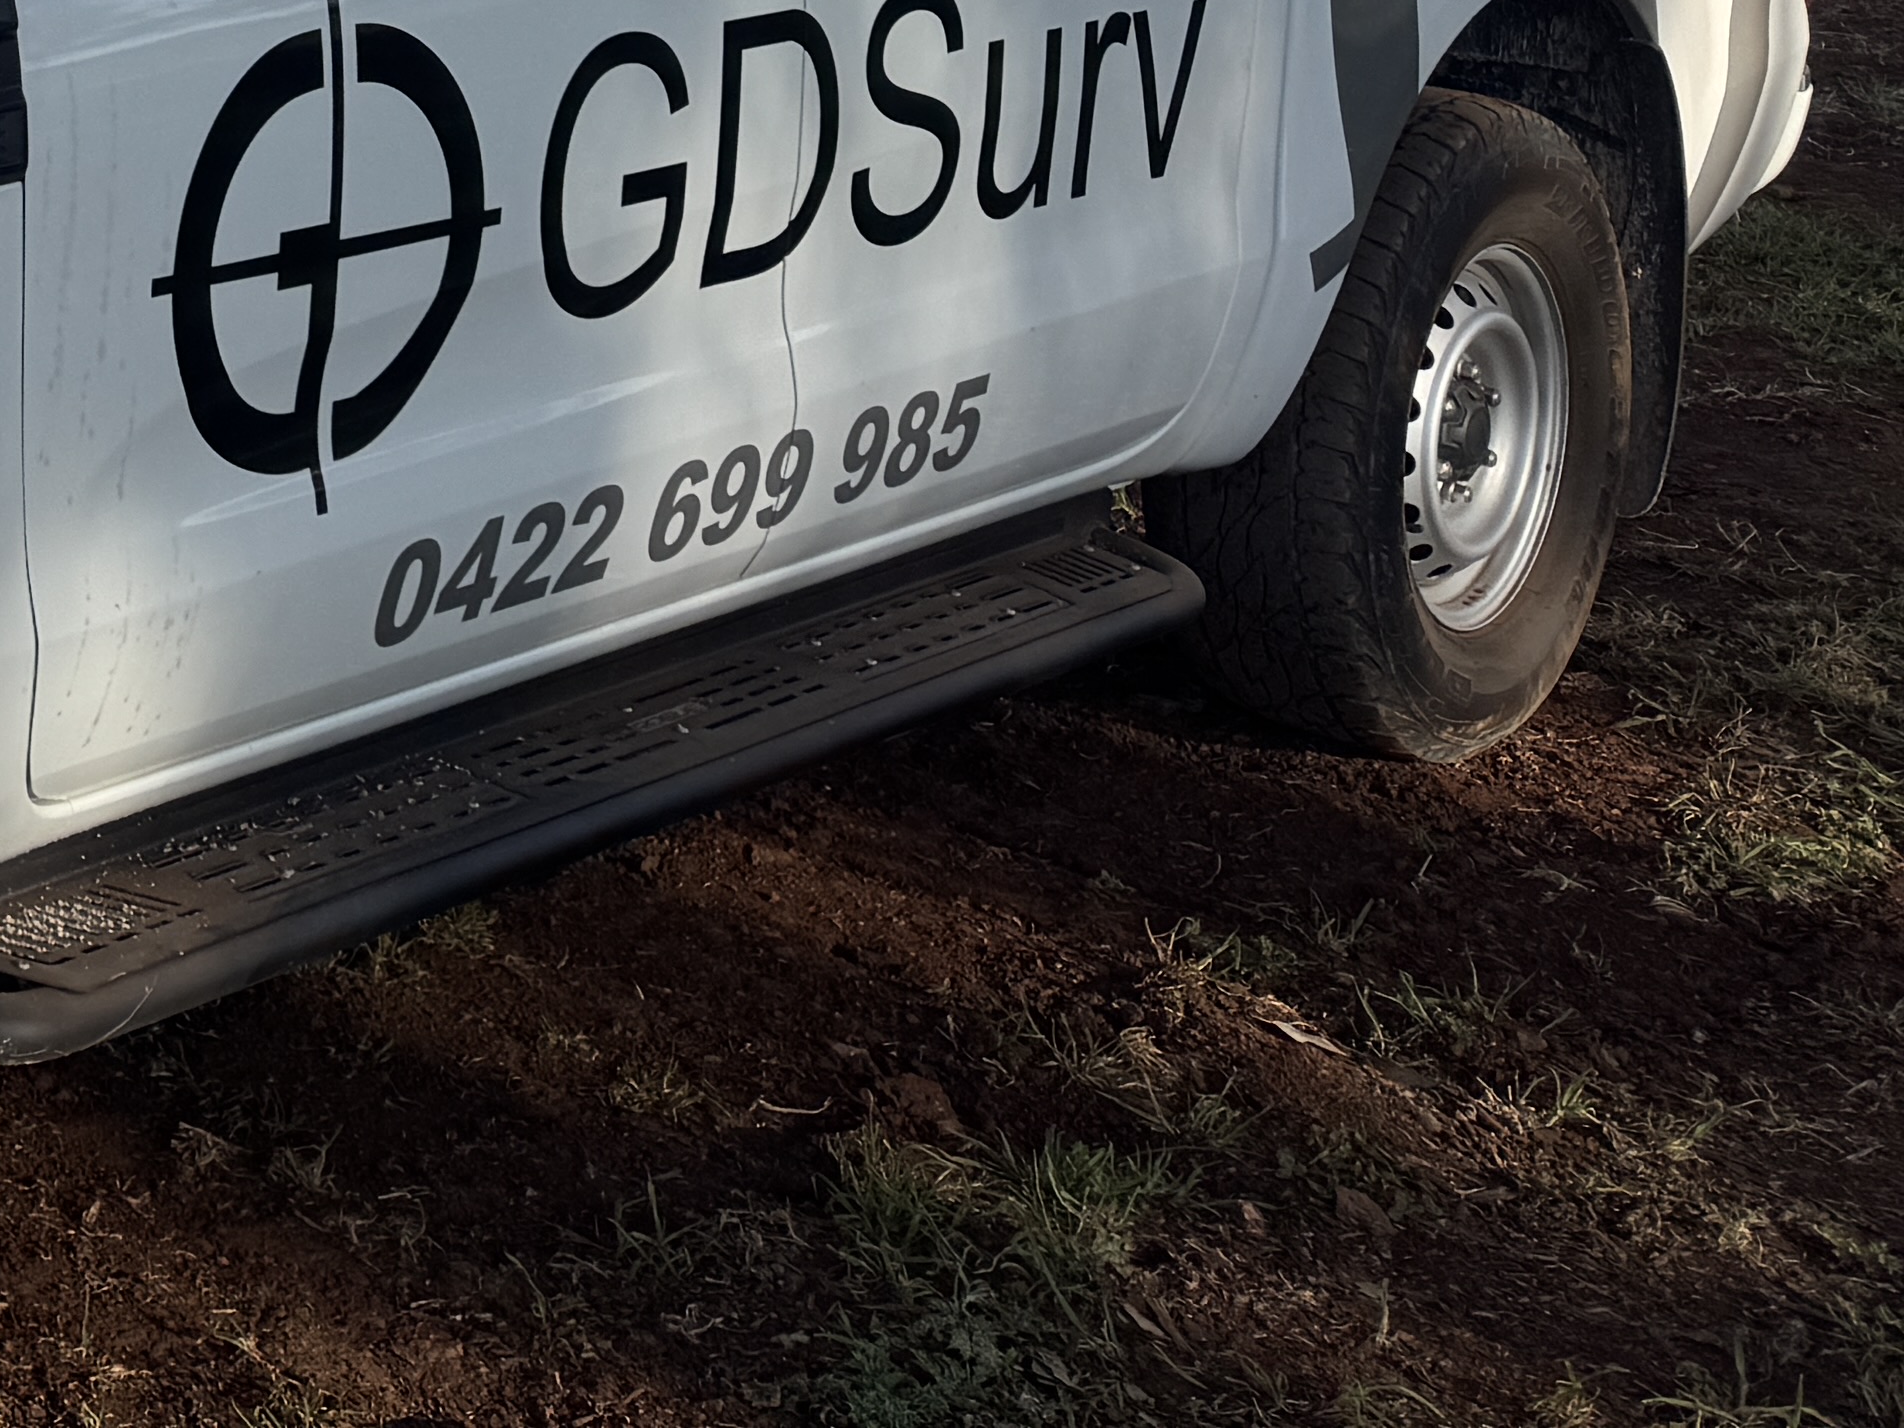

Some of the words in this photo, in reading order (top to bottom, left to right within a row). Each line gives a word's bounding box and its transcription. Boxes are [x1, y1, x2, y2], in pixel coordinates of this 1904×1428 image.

[372, 482, 625, 649] 0422
[647, 428, 815, 562] 699
[833, 372, 992, 505] 985
